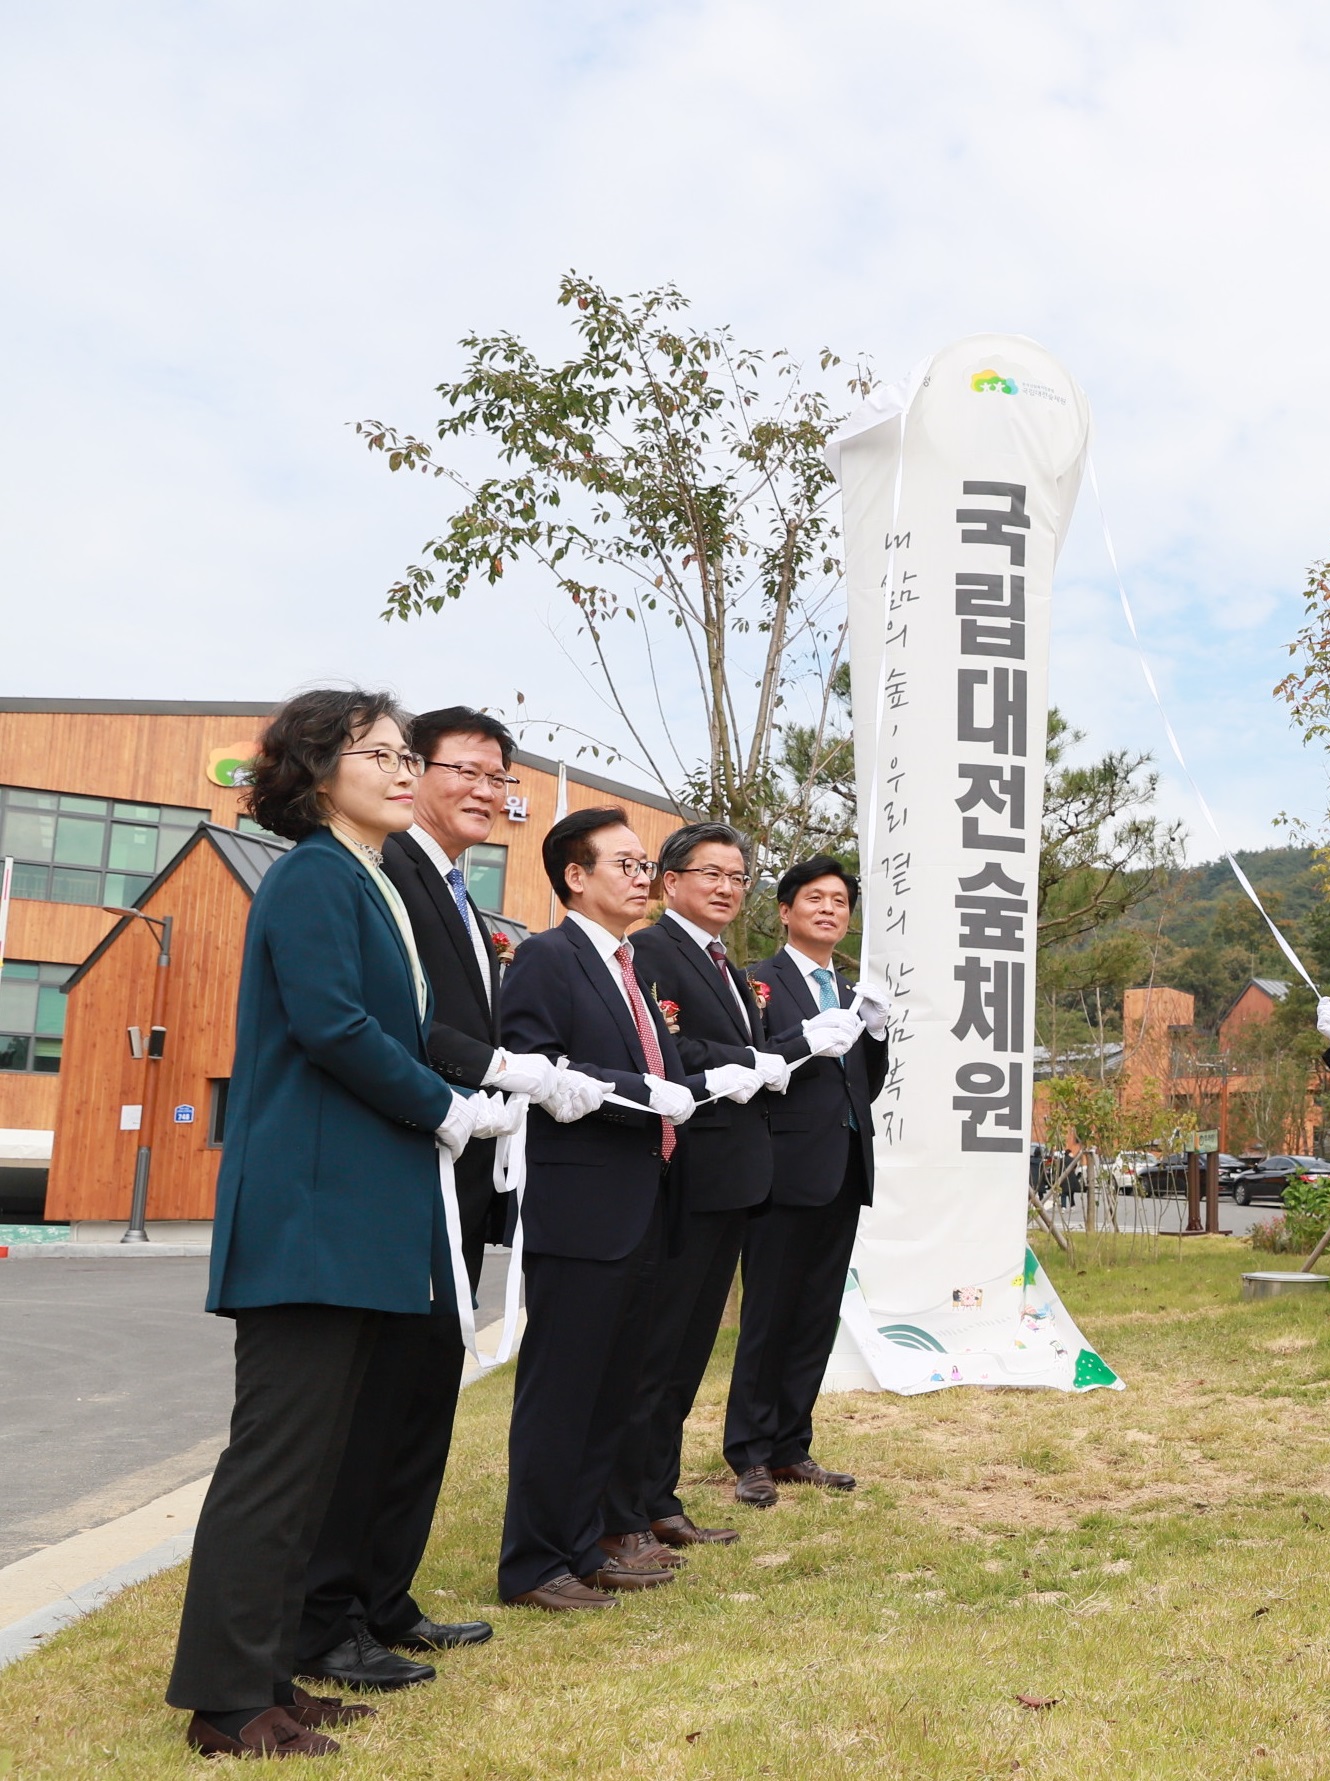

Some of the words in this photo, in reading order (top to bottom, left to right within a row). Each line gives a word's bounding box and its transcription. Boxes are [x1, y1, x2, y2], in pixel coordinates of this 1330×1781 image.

[884, 531, 911, 550] 내
[880, 570, 920, 648] 삶의
[883, 756, 908, 834] 우리
[951, 481, 1031, 1154] 국립대전숲체원
[881, 852, 911, 936] 곁의
[884, 962, 915, 1146] 산림복지
